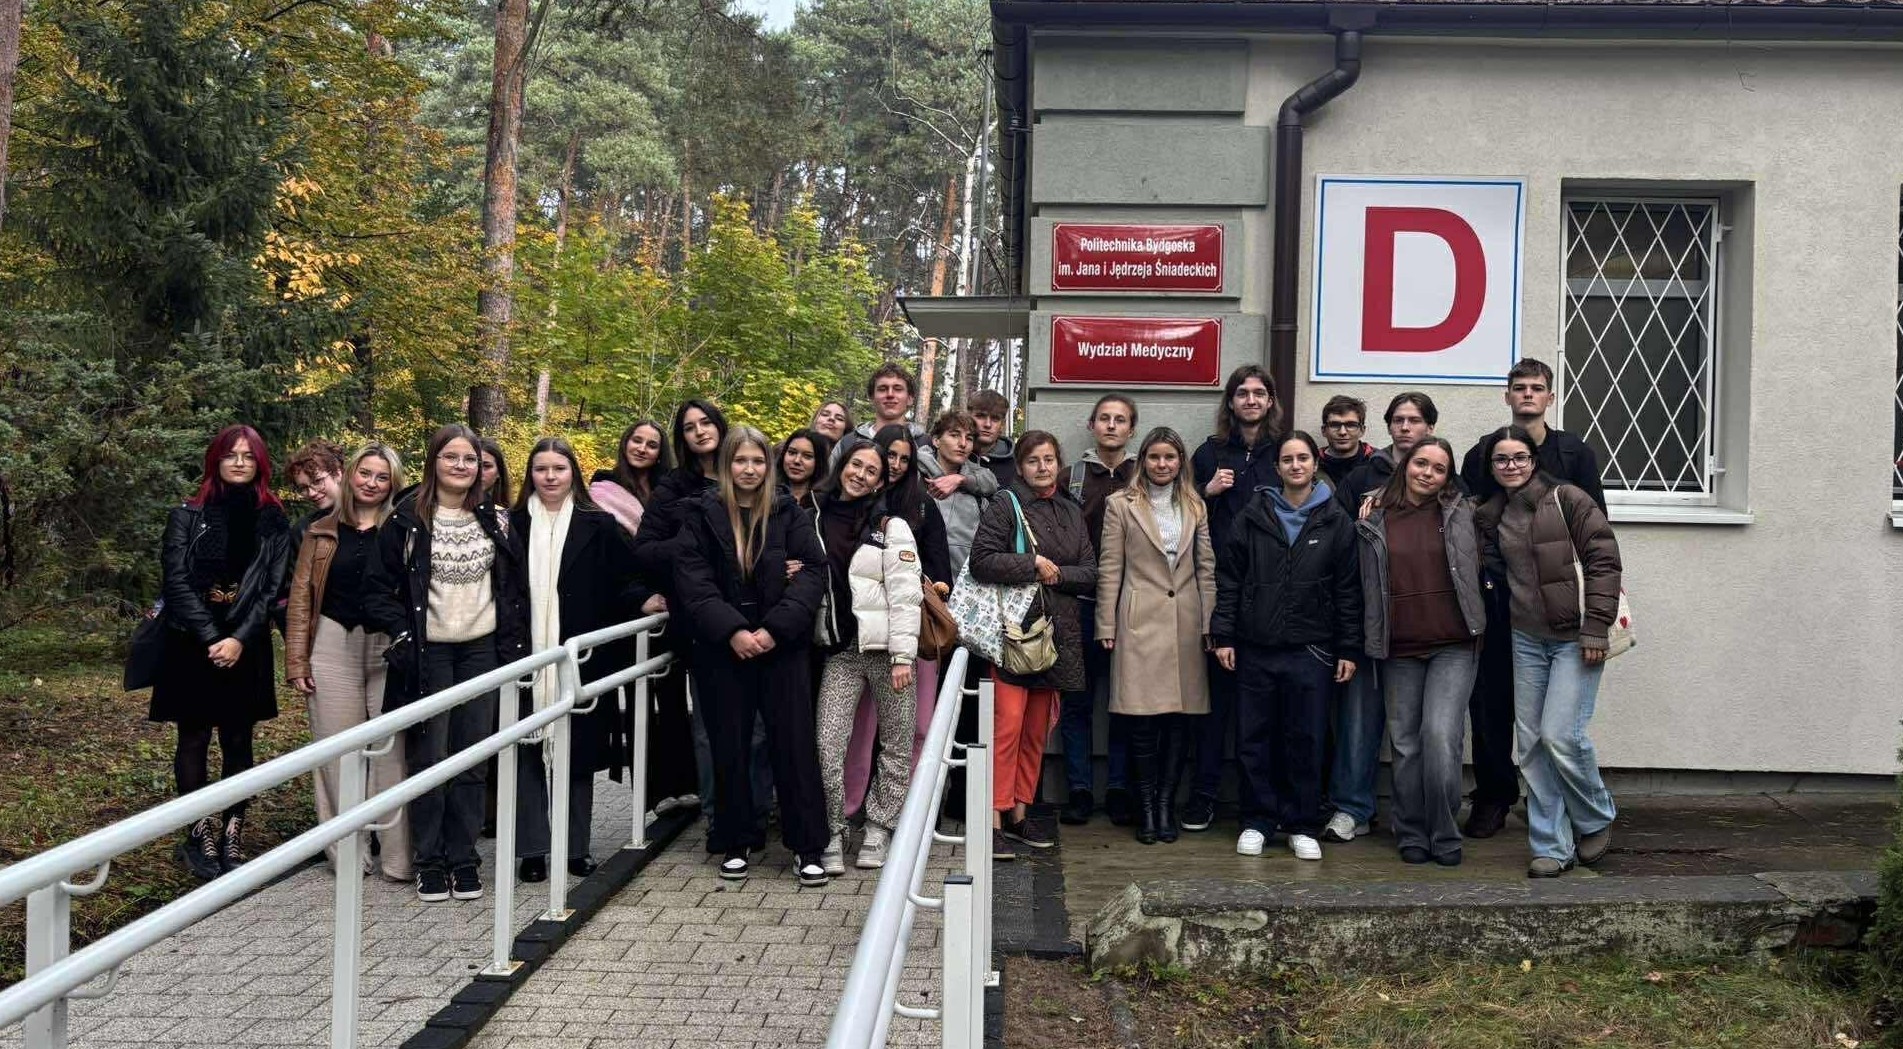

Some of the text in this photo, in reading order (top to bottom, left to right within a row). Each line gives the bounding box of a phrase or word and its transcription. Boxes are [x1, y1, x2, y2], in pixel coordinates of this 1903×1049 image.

[1080, 237, 1195, 254] Politechnika Bydgoska
[1058, 259, 1217, 279] im. Jana i Jędrzeja Śniadeckich
[1361, 206, 1487, 353] D
[1077, 341, 1194, 361] Wydział Medyczny
